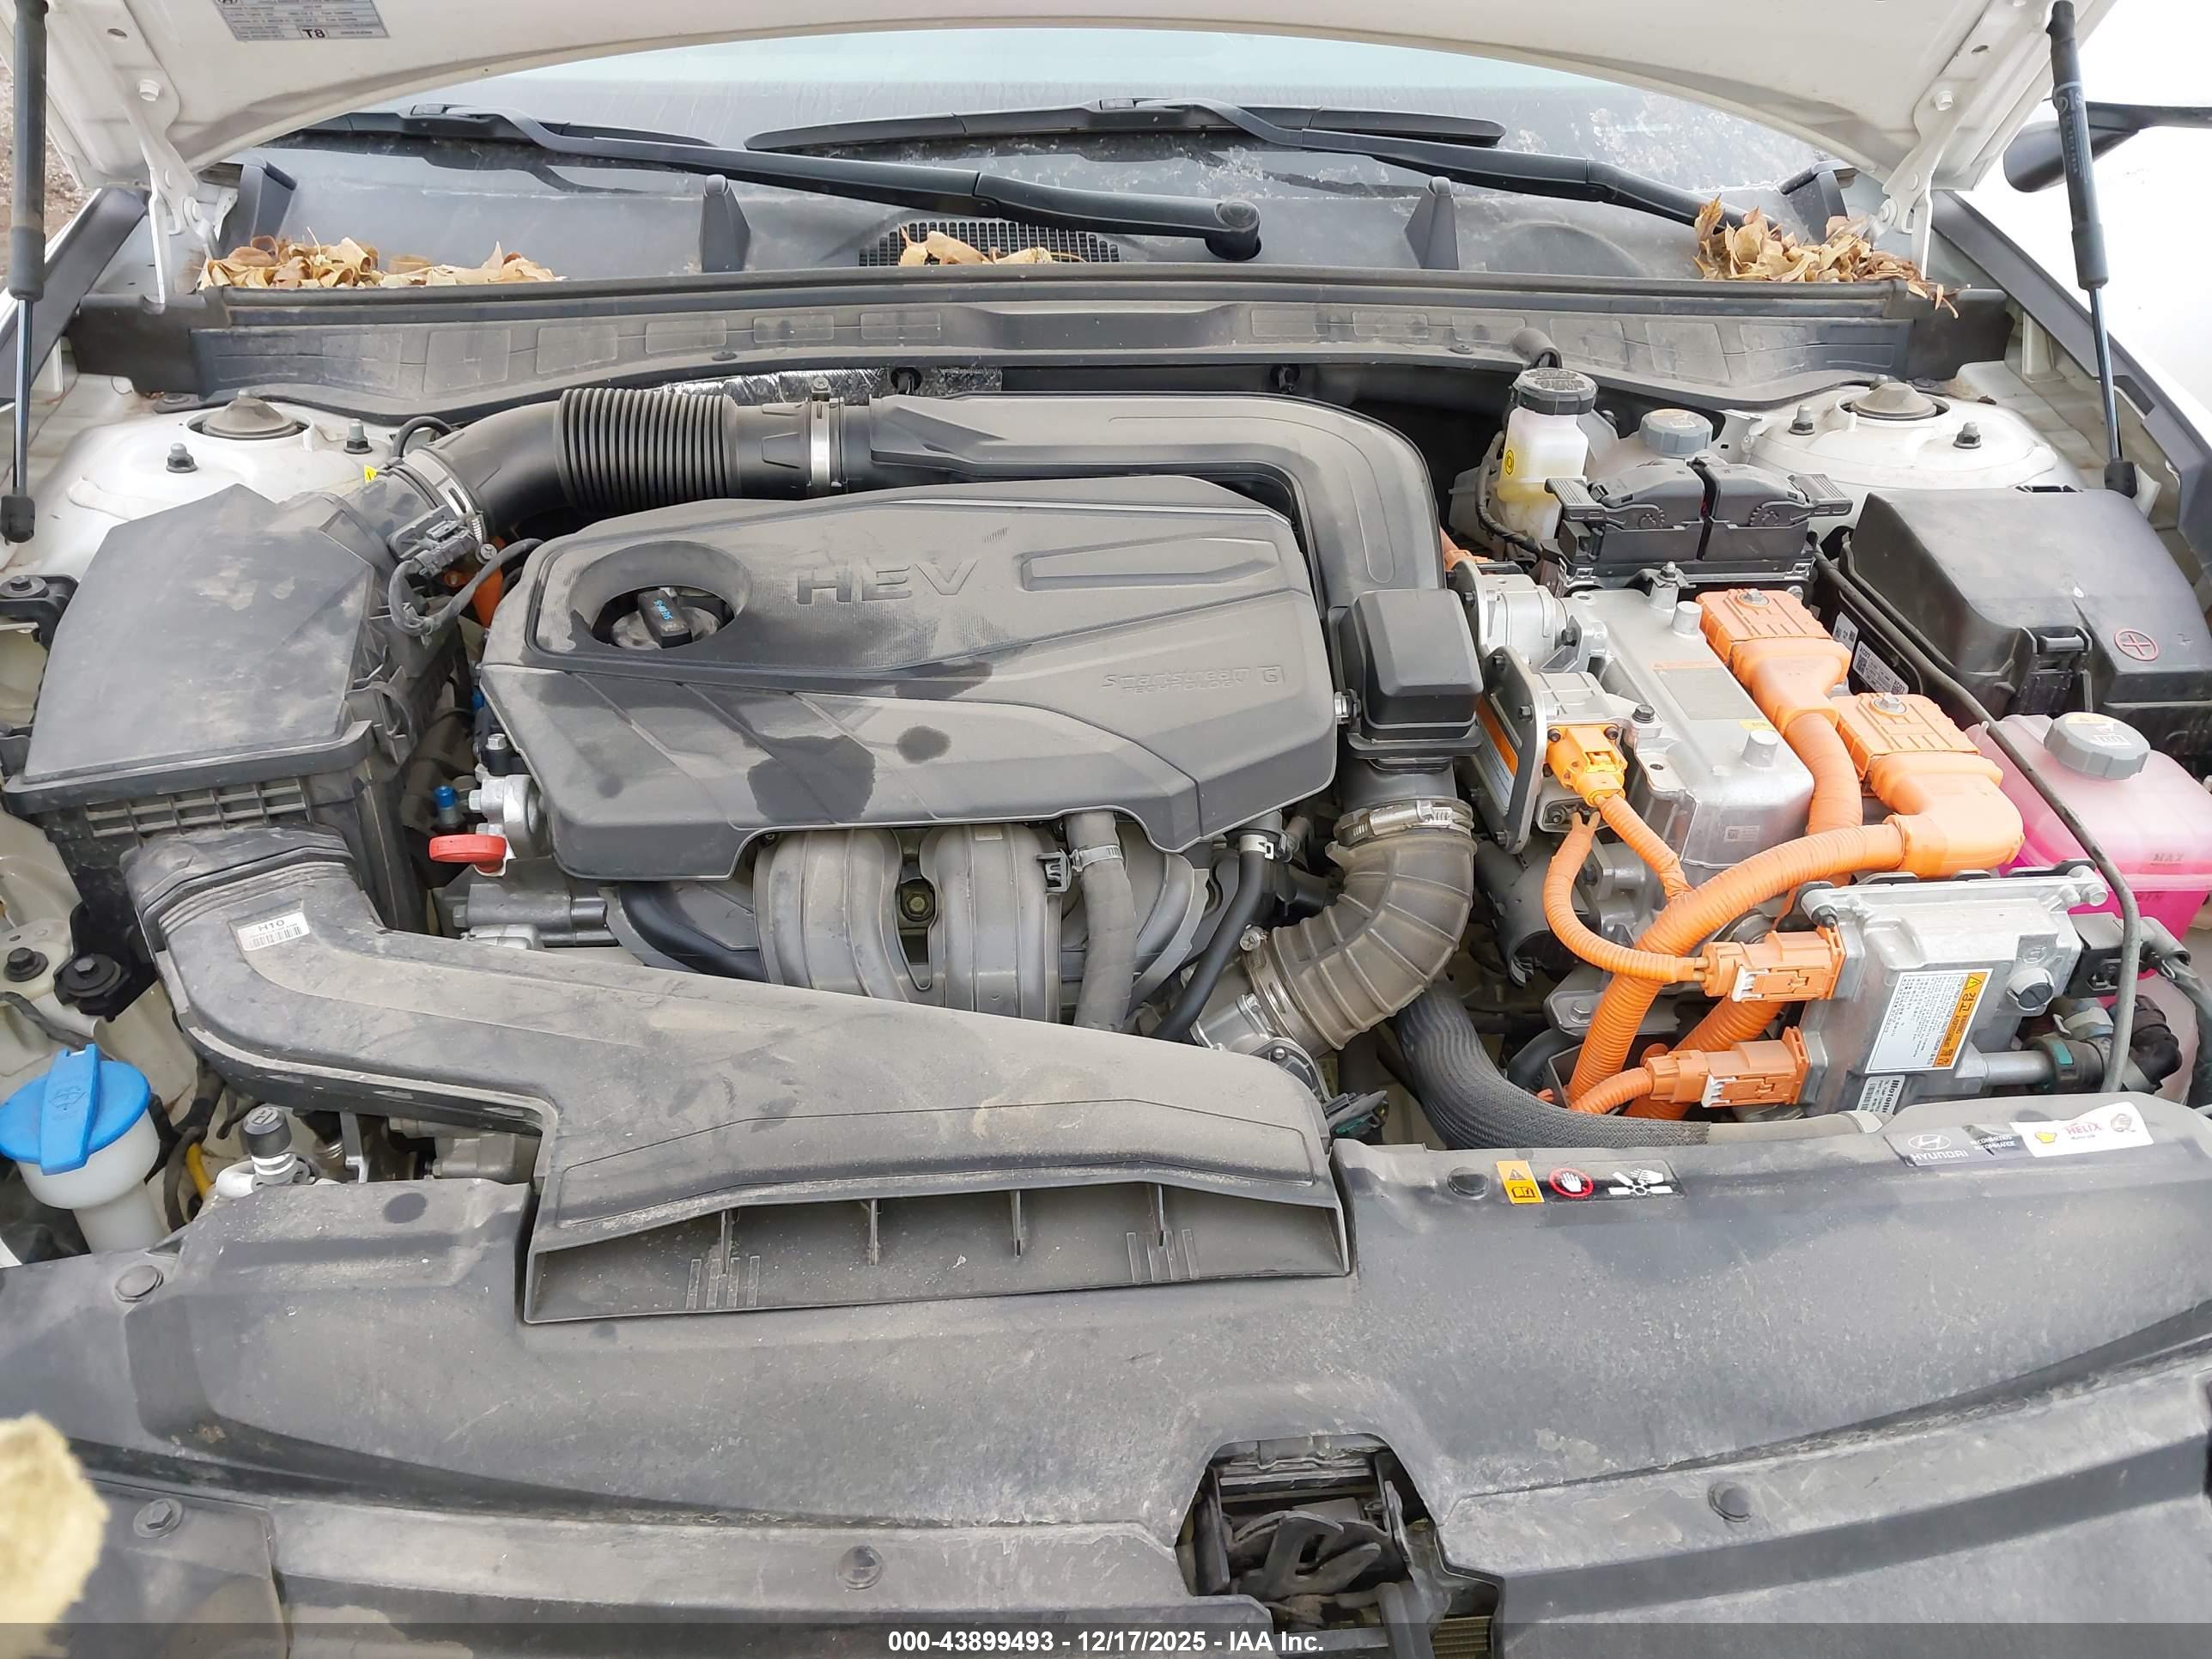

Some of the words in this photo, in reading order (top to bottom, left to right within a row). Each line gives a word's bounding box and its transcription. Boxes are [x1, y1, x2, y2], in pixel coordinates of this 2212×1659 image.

[302, 28, 325, 39] T8
[797, 559, 979, 605] HEV
[2152, 852, 2185, 862] MAX
[258, 920, 285, 933] H10
[1959, 992, 1977, 1012] 경고
[2065, 1123, 2104, 1135] HELIX
[1910, 1149, 1969, 1161] HYUNDAI
